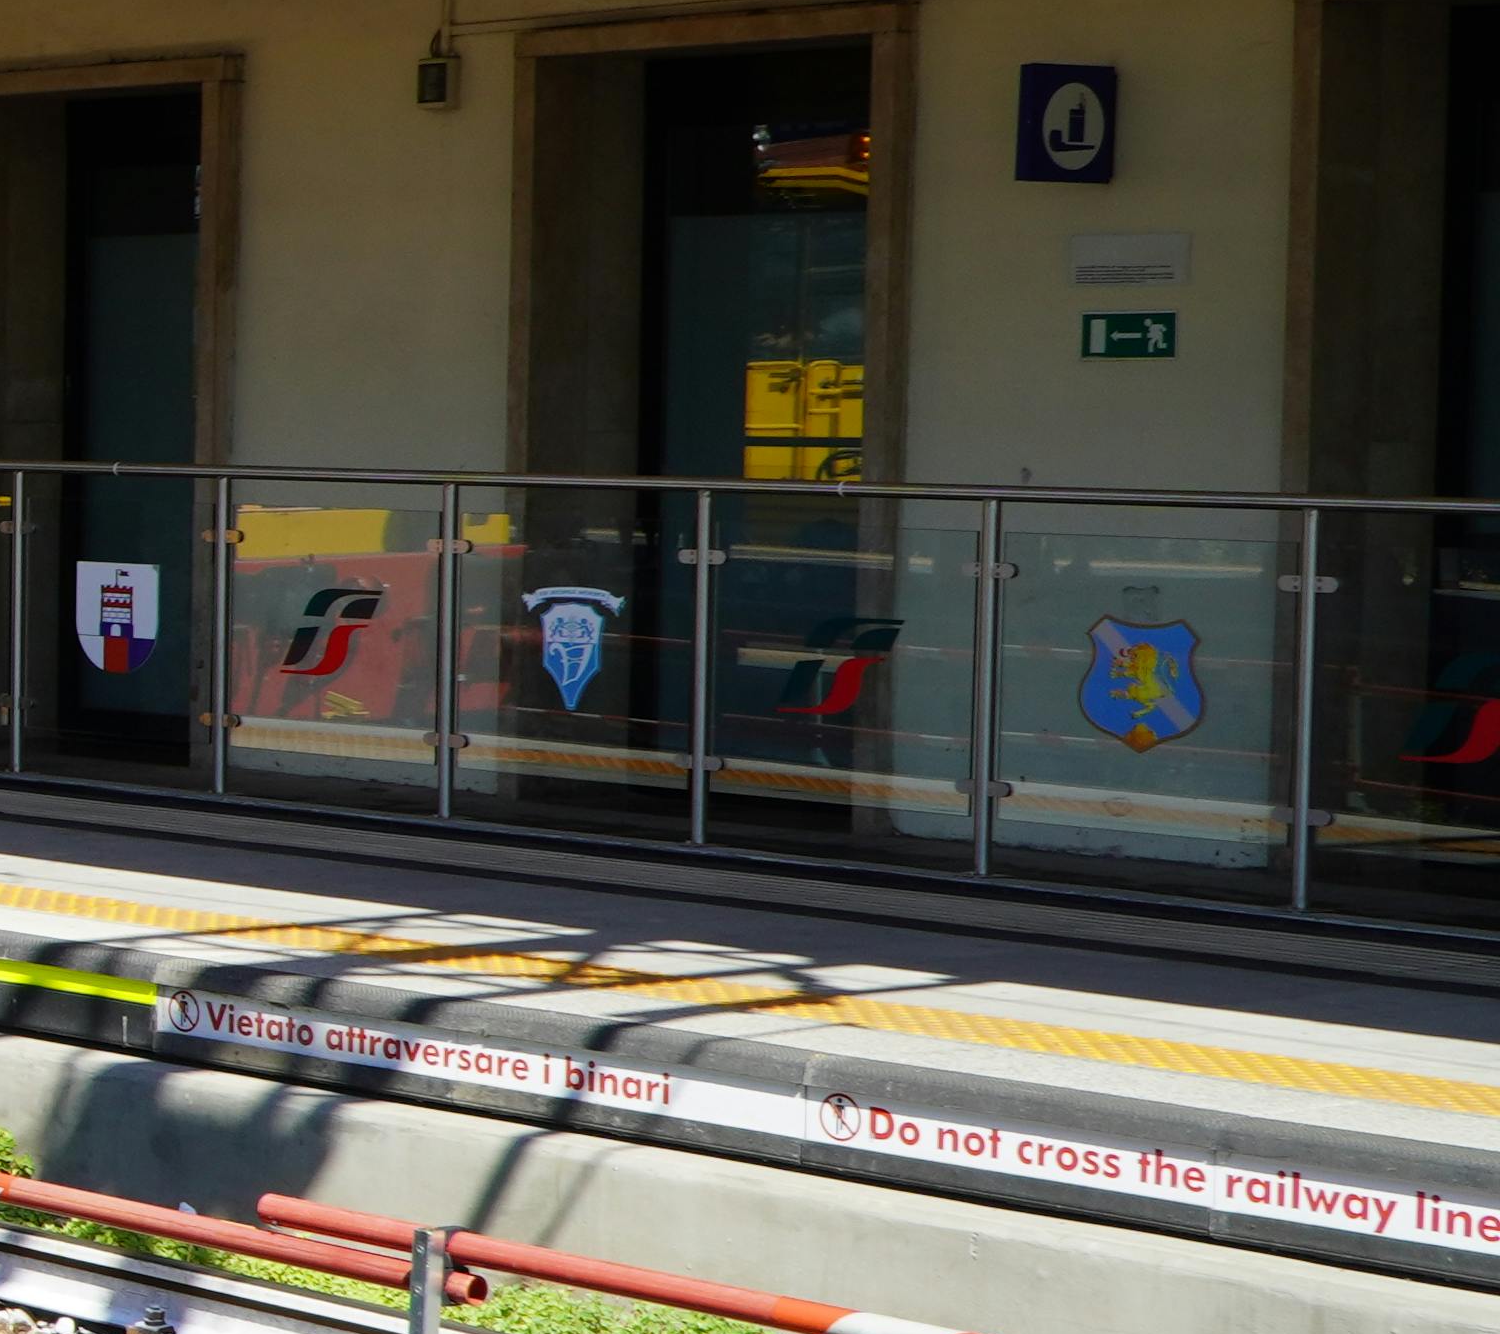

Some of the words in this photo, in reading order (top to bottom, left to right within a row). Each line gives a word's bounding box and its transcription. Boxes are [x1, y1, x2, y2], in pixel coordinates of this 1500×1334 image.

[205, 1001, 313, 1045] Vietato
[325, 1027, 528, 1081] attraversare
[543, 1054, 550, 1084] i
[565, 1055, 670, 1105] binari
[869, 1106, 920, 1145] Do
[937, 1128, 1001, 1159] not
[1018, 1140, 1121, 1179] cross
[1138, 1149, 1206, 1192] the
[1226, 1170, 1397, 1234] railway
